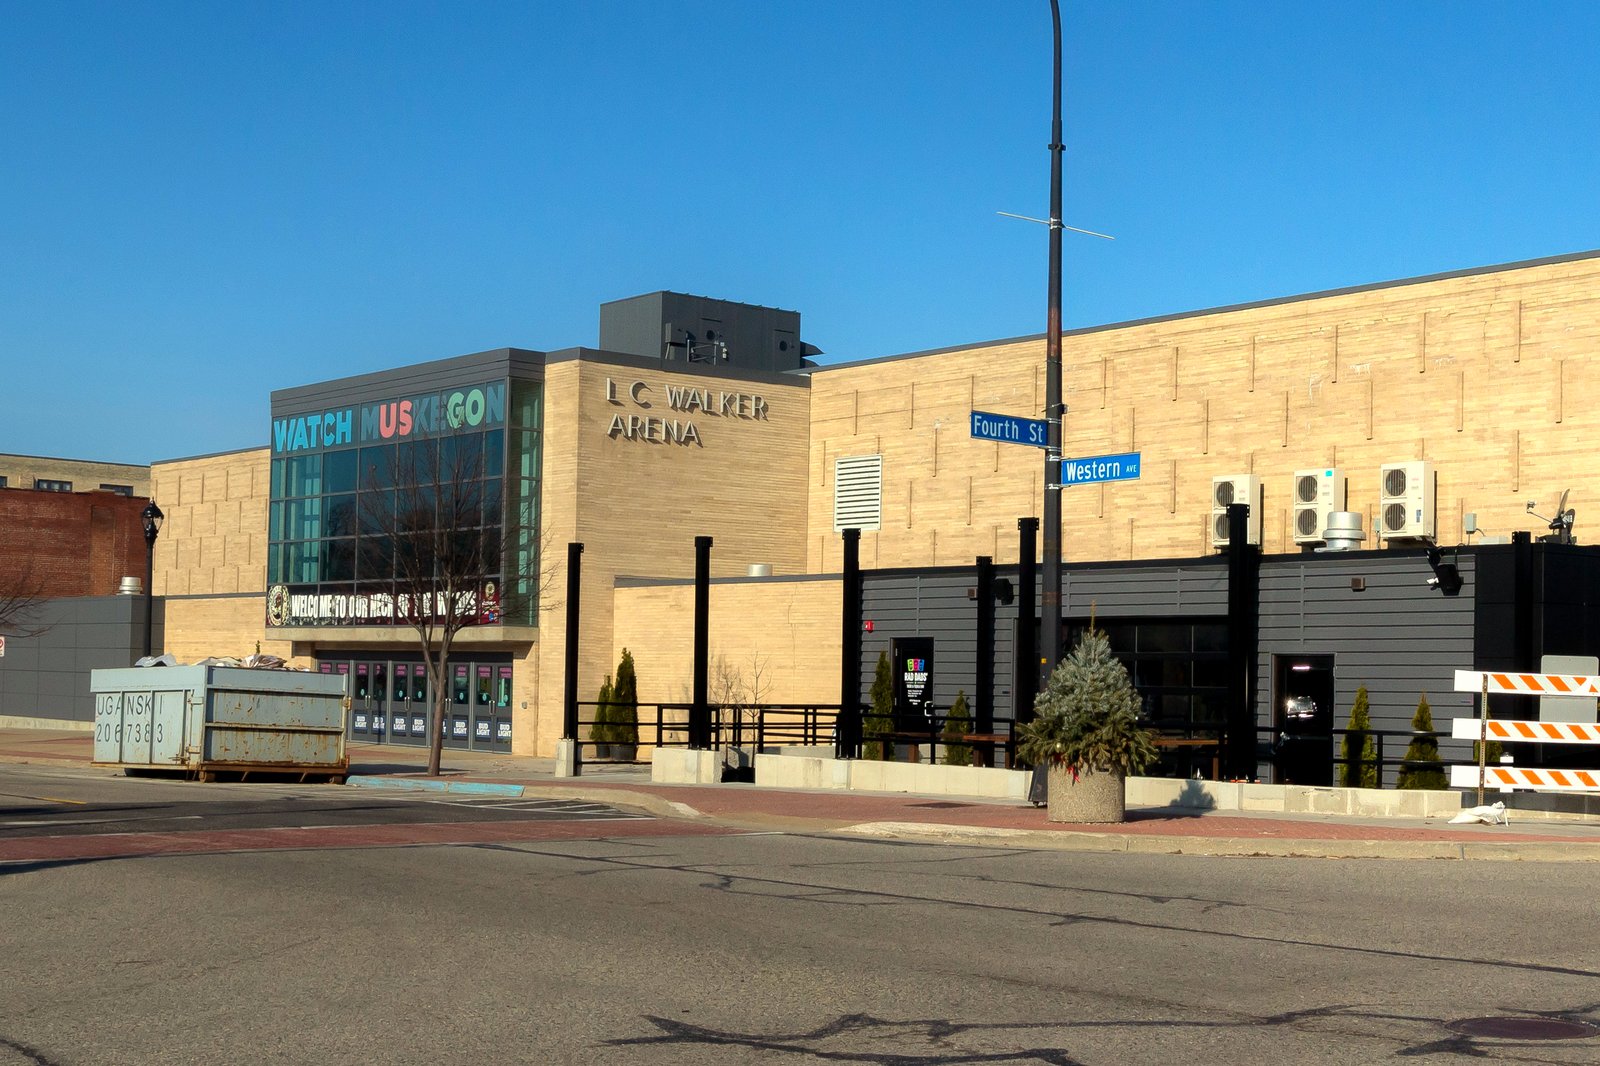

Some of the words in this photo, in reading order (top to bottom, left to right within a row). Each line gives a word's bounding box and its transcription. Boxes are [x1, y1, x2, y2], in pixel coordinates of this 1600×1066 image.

[606, 377, 617, 401] L
[629, 381, 653, 404] C
[665, 384, 768, 419] WALKER
[273, 410, 352, 452] WATCH
[361, 384, 505, 441] MUSKEGON
[607, 413, 699, 444] ARENA
[973, 415, 1019, 440] Fourth
[1029, 423, 1043, 443] St
[1066, 461, 1121, 482] Western
[1125, 464, 1137, 473] AVE
[291, 594, 332, 618] WELCOME
[335, 594, 347, 619] TO
[349, 594, 368, 618] OUR
